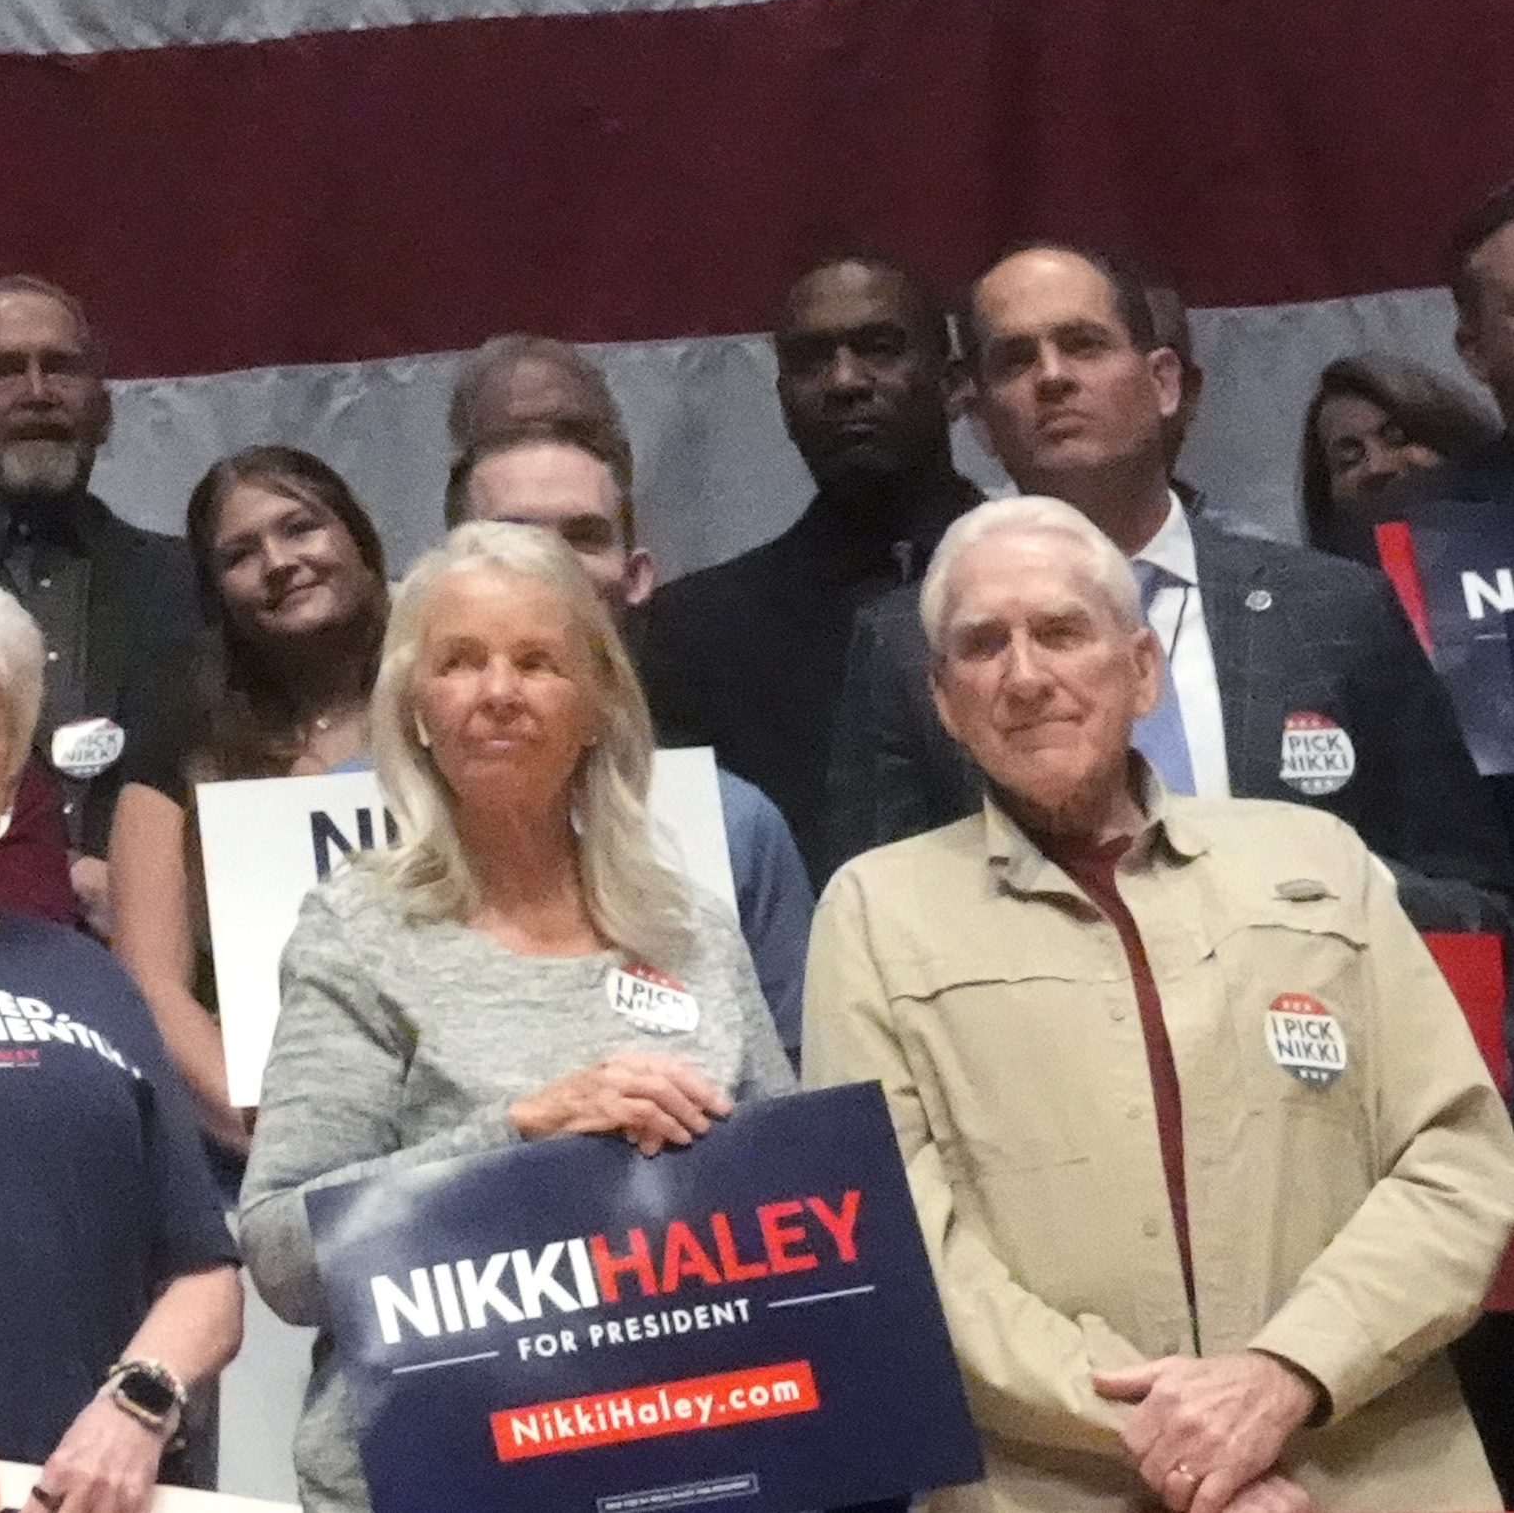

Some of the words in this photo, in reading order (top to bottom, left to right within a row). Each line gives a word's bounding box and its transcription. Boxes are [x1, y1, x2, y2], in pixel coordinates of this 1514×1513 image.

[1289, 734, 1343, 753] PICK
[1281, 753, 1349, 771] NIKKI
[1271, 1015, 1278, 1035] I
[1284, 1018, 1335, 1041] PICK
[1276, 1038, 1340, 1063] NIKKI
[370, 1189, 861, 1344] NIKKIHALEY
[517, 1328, 577, 1360] FOR
[589, 1298, 751, 1348] PRESIDENT
[510, 1378, 801, 1446] NikkiHaley.com
